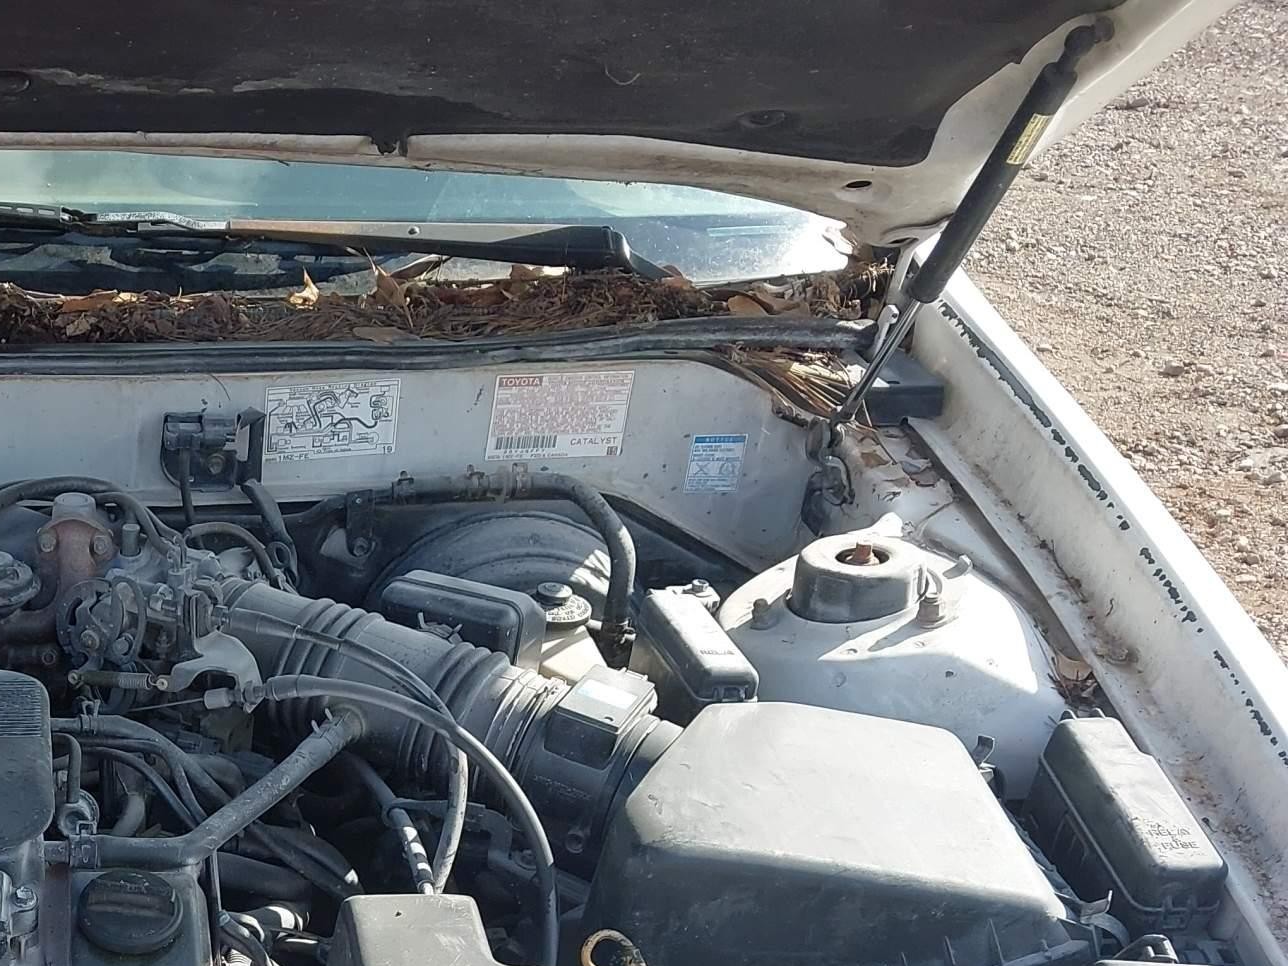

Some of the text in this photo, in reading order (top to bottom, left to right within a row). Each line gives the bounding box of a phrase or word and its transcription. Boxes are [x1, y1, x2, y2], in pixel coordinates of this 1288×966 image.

[501, 377, 541, 386] TOYOTA
[570, 436, 618, 446] CATALYST
[382, 446, 393, 454] 19
[278, 453, 310, 463] 1MZ-FE
